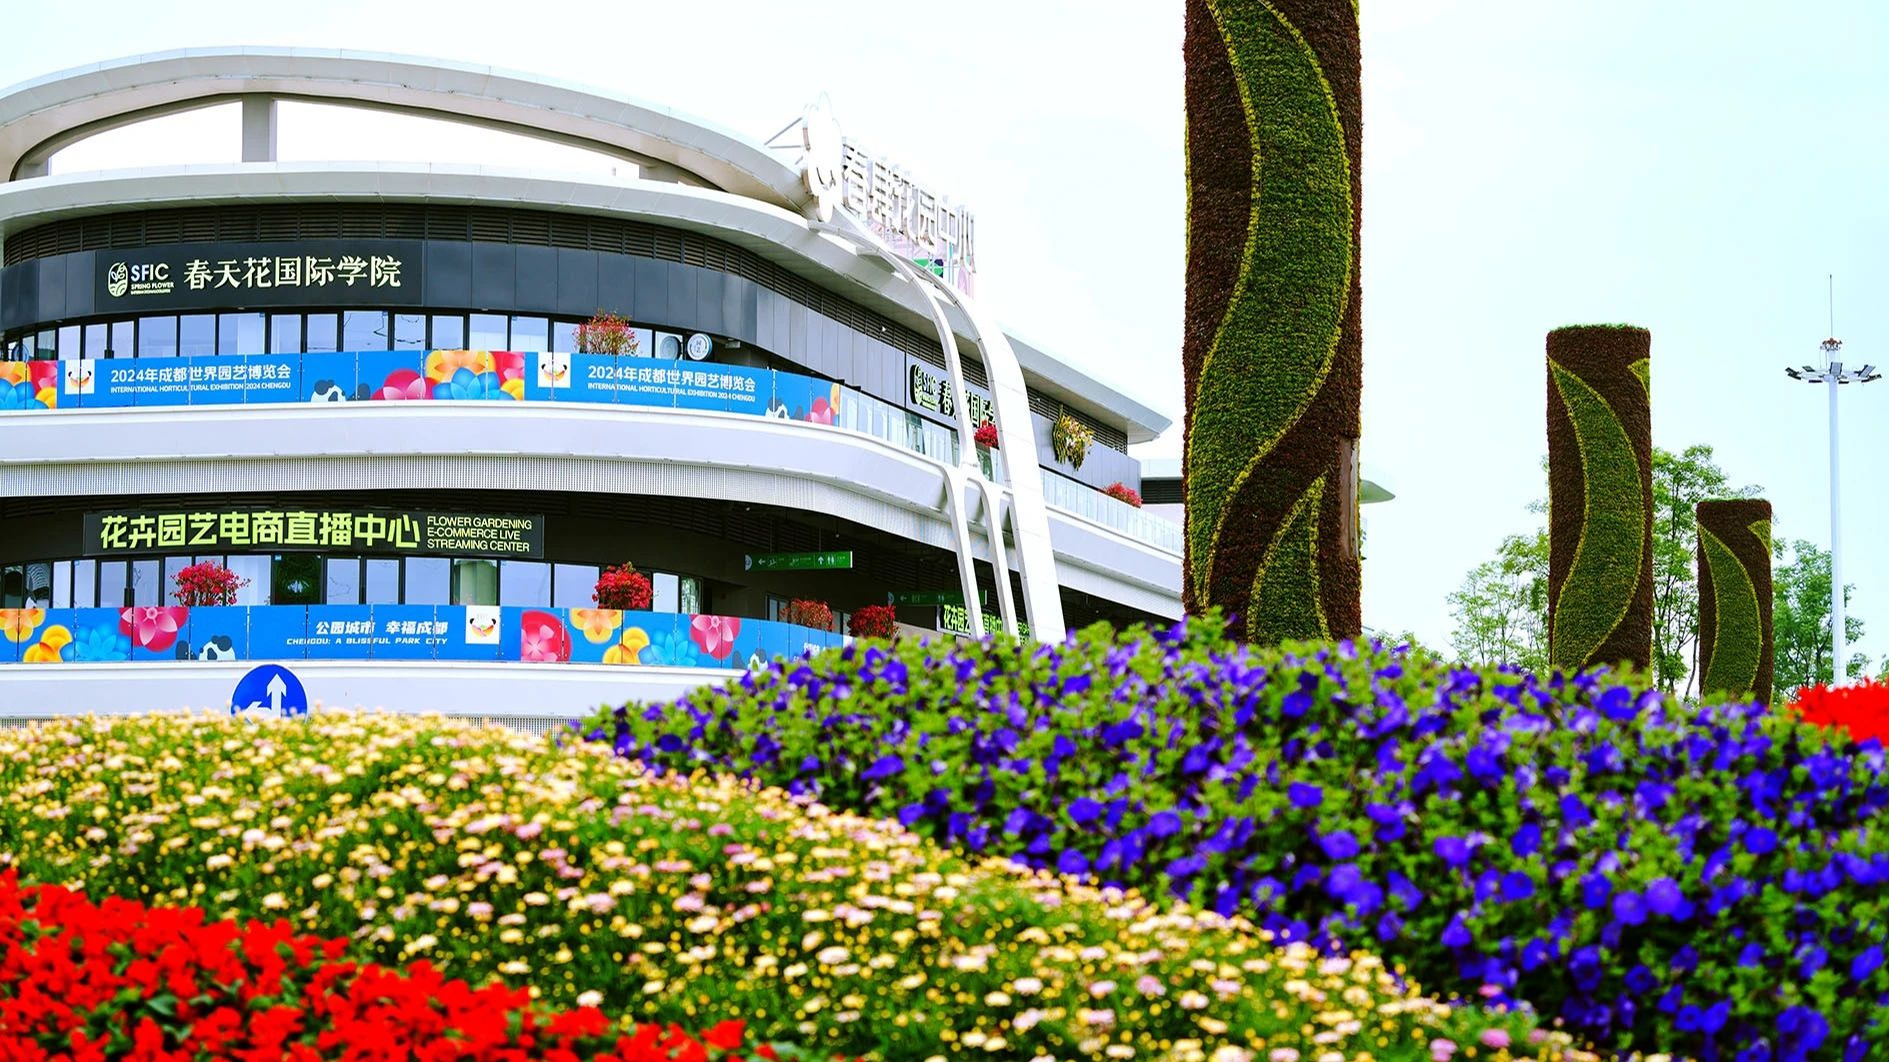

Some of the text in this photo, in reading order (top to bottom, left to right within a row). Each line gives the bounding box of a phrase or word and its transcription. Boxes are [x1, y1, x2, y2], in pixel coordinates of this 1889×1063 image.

[131, 263, 169, 282] SFIC
[184, 255, 402, 290] 春天花国际学院
[111, 364, 291, 382] 2024年成都世界园艺博览会
[588, 365, 756, 392] 2024年成都世界园艺博览会
[111, 385, 158, 393] INTERNATIONAL
[160, 383, 209, 392] HORTICULTURAL
[210, 383, 243, 391] EXHIBITION
[588, 382, 638, 392] INTERNATIONAL
[639, 385, 686, 396] HORTICULTURAL
[687, 389, 717, 399] EXHIBITION
[100, 511, 421, 548] 花卉园艺电商直播中心
[427, 516, 532, 530] FLOWER GARDENING
[427, 527, 520, 540] E-COMMERCE LIVE
[427, 538, 530, 552] STREAMING CENTER
[316, 621, 449, 635] 公园城市 幸福成都
[346, 637, 391, 645] BLISSFUL
[395, 637, 420, 645] PARK
